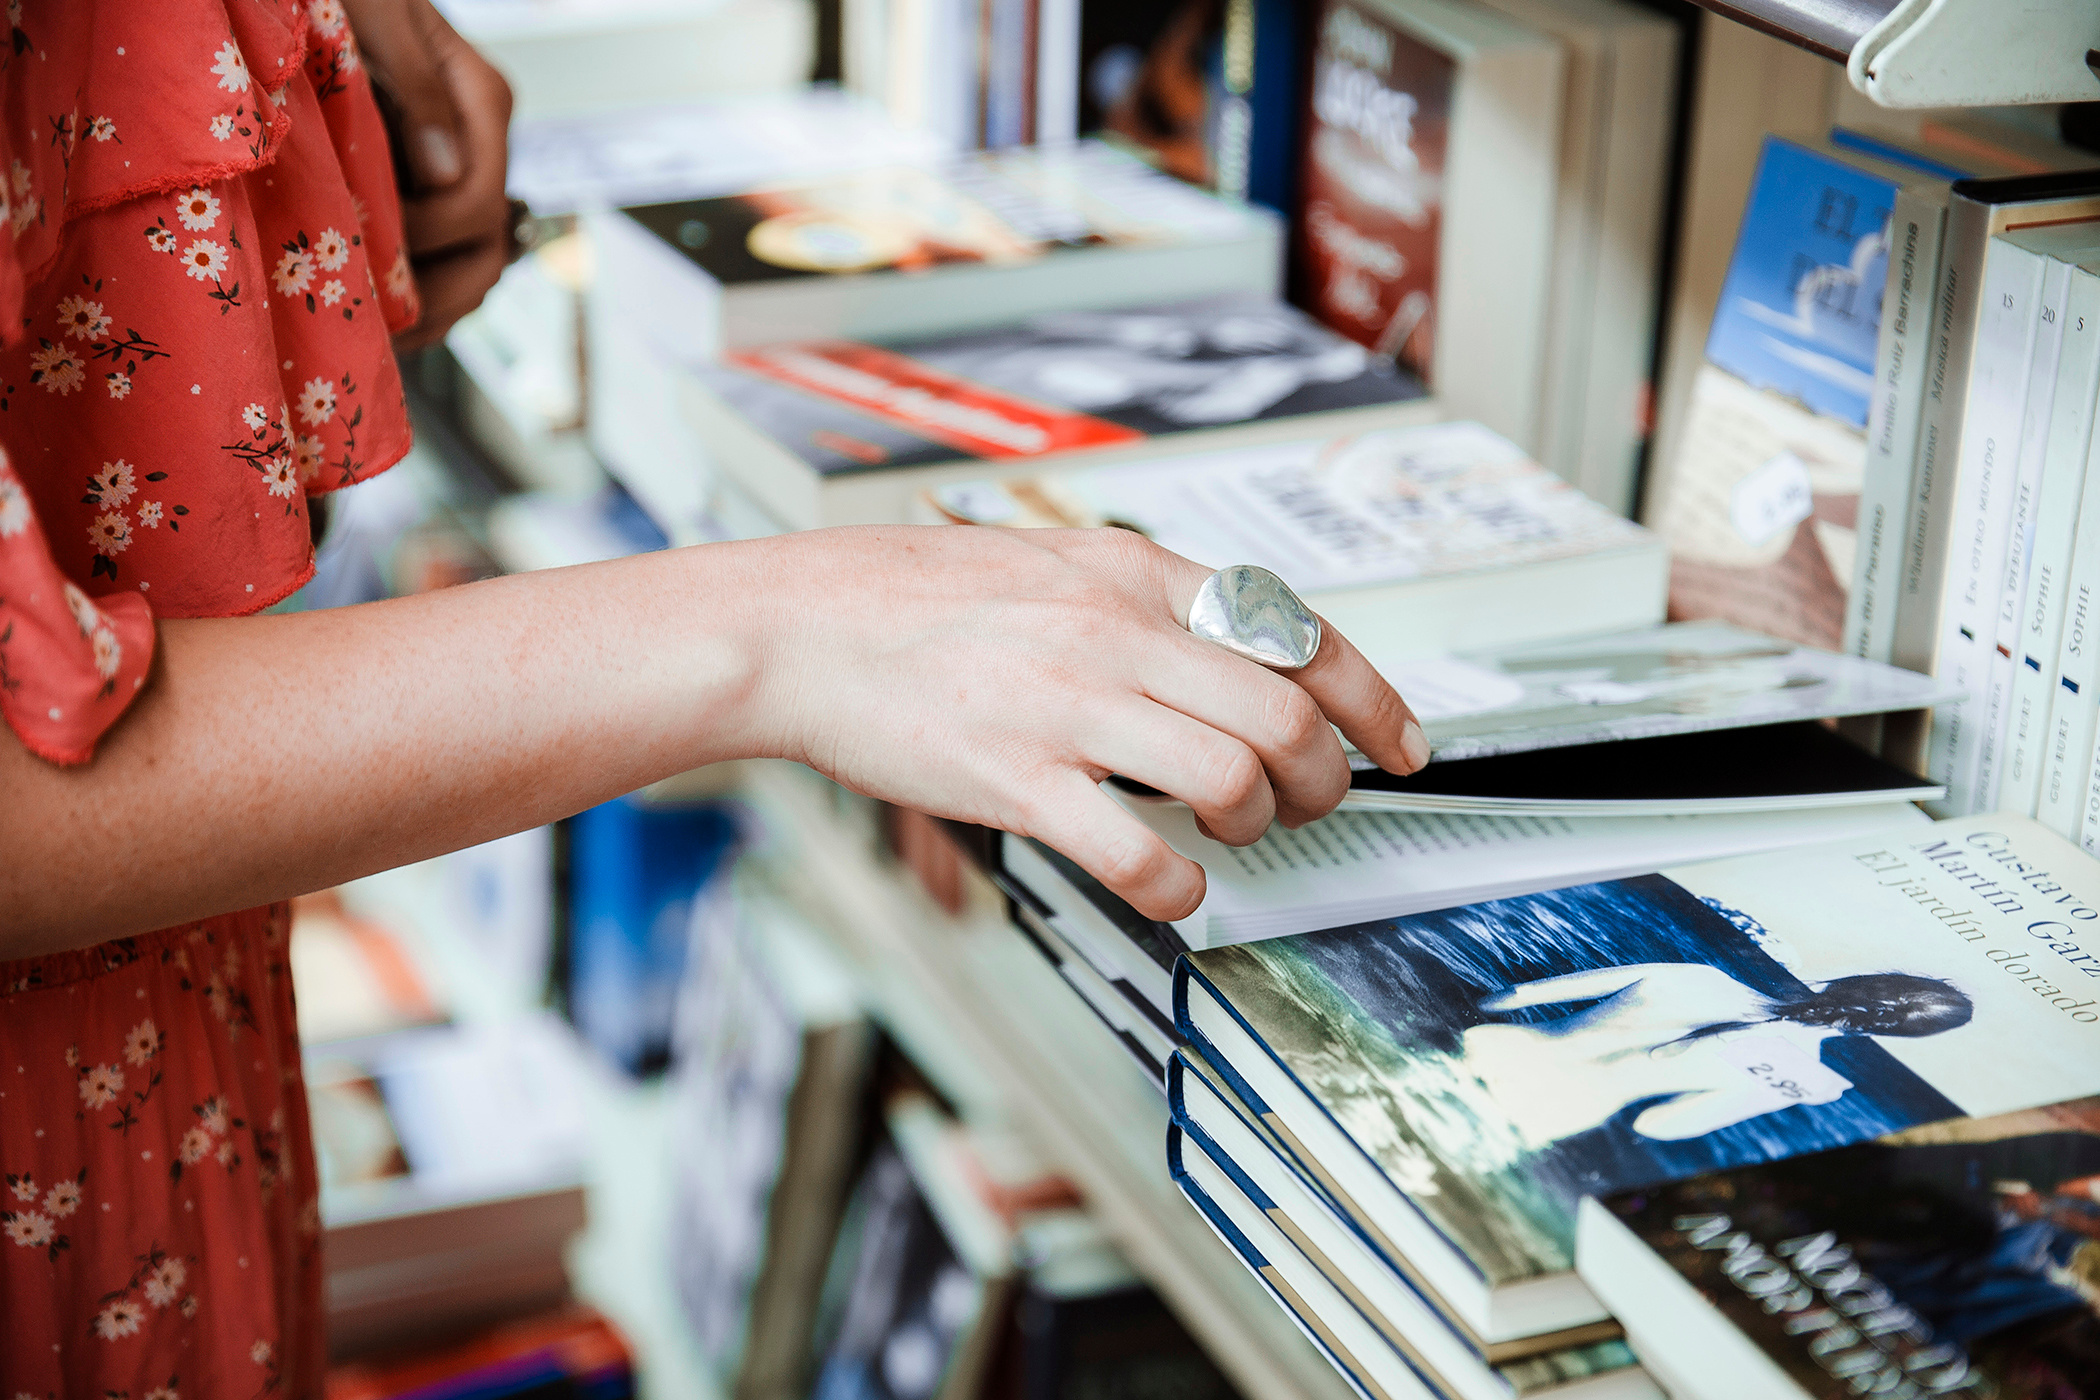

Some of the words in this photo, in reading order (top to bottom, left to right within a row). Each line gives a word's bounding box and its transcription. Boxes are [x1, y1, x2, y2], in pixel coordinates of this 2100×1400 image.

[2003, 292, 2014, 311] 15
[2041, 304, 2056, 325] 20
[2076, 316, 2085, 332] 5
[1887, 342, 1904, 390] Ruiz
[1979, 437, 1996, 514] MUNDO
[2008, 481, 2031, 593] DEBUTANTE
[2031, 564, 2052, 637] SOPHIE
[2069, 583, 2092, 657] SOPHIE
[2018, 694, 2032, 742] BURT
[2055, 715, 2070, 763] BURT
[2013, 744, 2025, 783] GUY
[2049, 766, 2062, 804] GUY
[1852, 849, 1909, 873] El
[1908, 840, 2025, 915] Martín
[1966, 831, 2099, 921] Gustavo
[1878, 877, 1986, 943] jardín
[1985, 949, 2099, 1023] dorado
